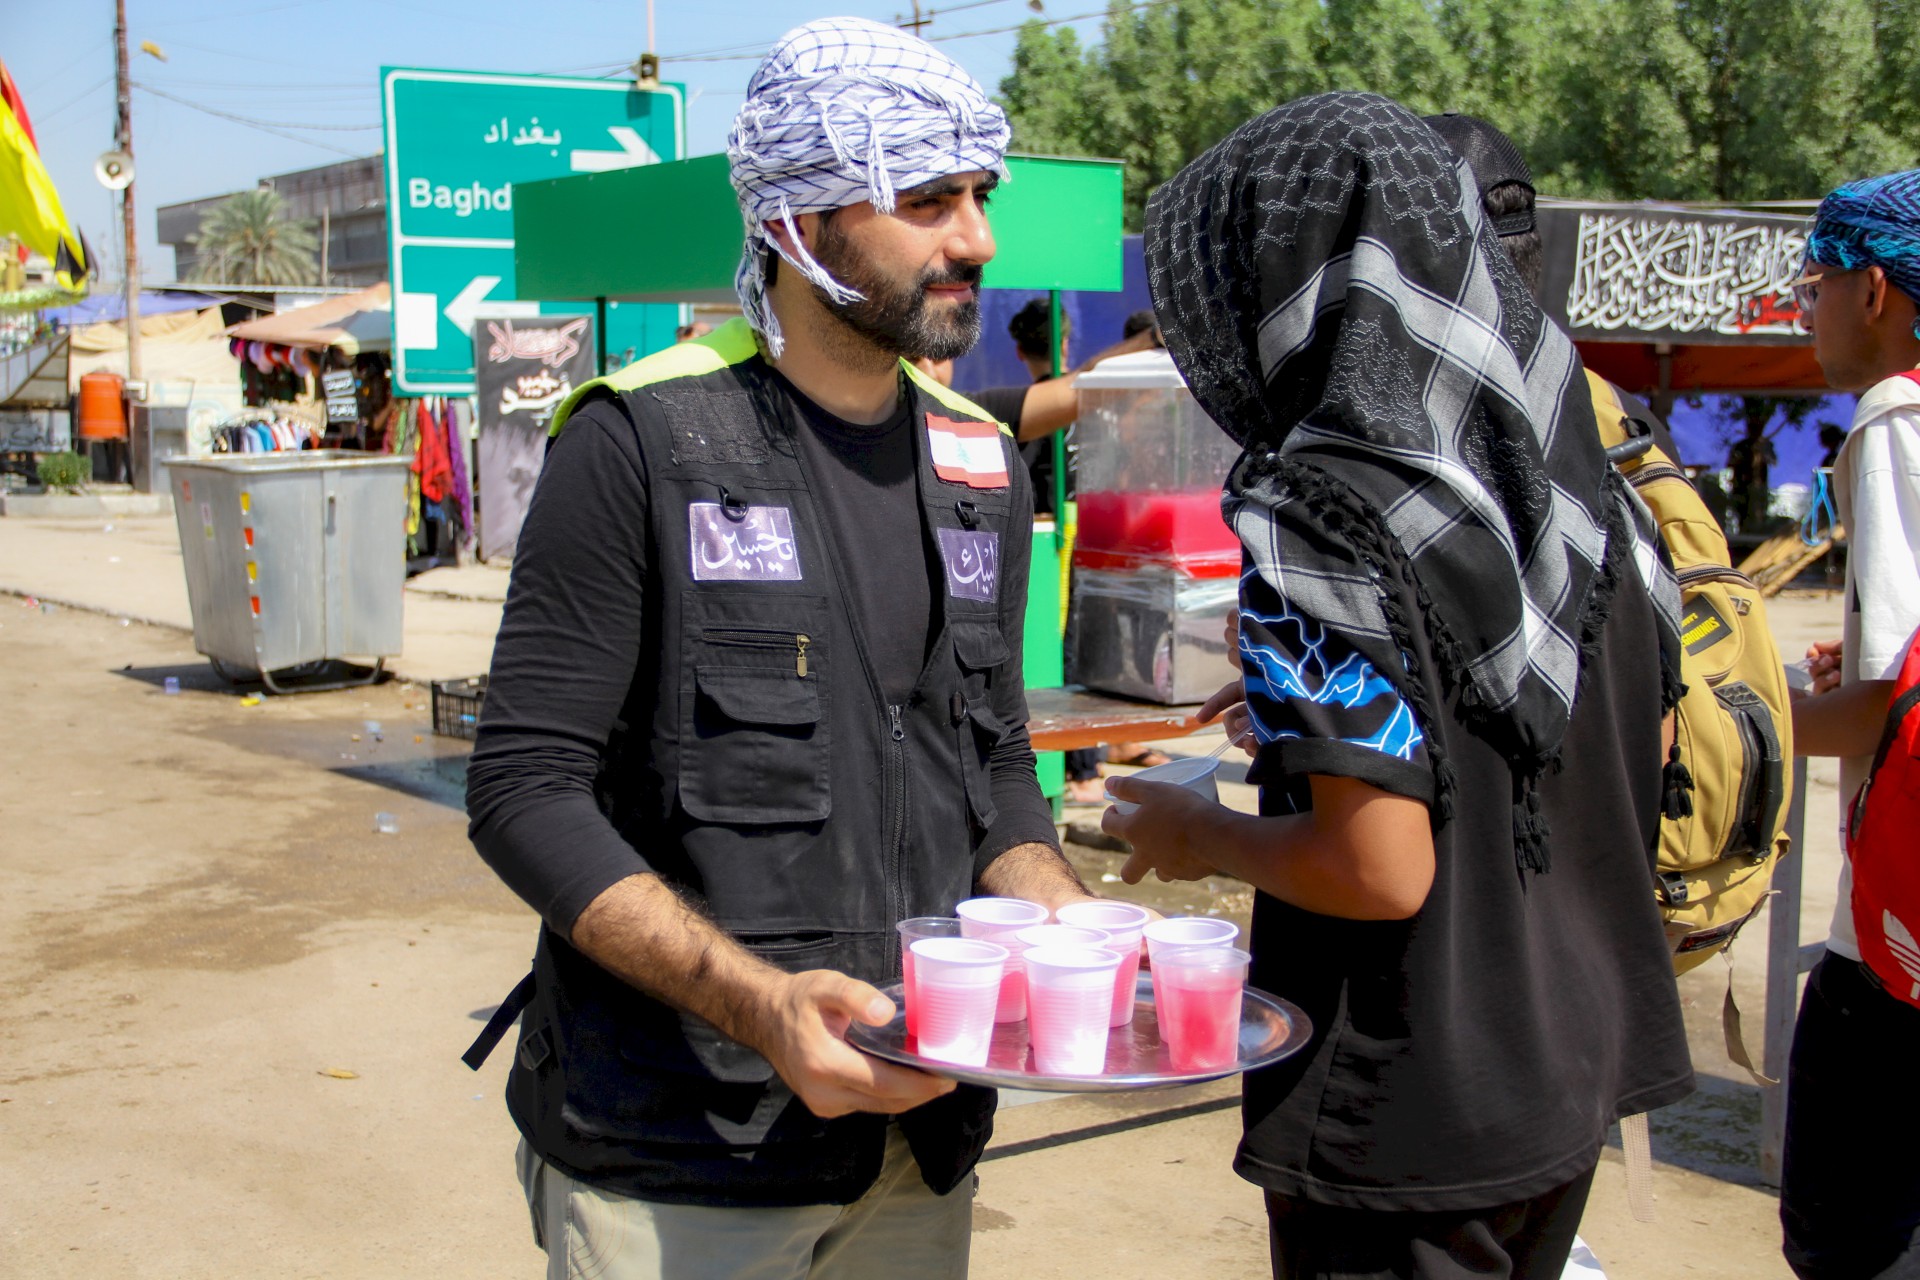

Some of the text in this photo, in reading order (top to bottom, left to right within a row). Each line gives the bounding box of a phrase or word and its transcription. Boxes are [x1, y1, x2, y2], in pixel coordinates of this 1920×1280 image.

[484, 117, 562, 157] بغداد
[409, 178, 512, 217] Baghd
[951, 539, 995, 596] لبيك
